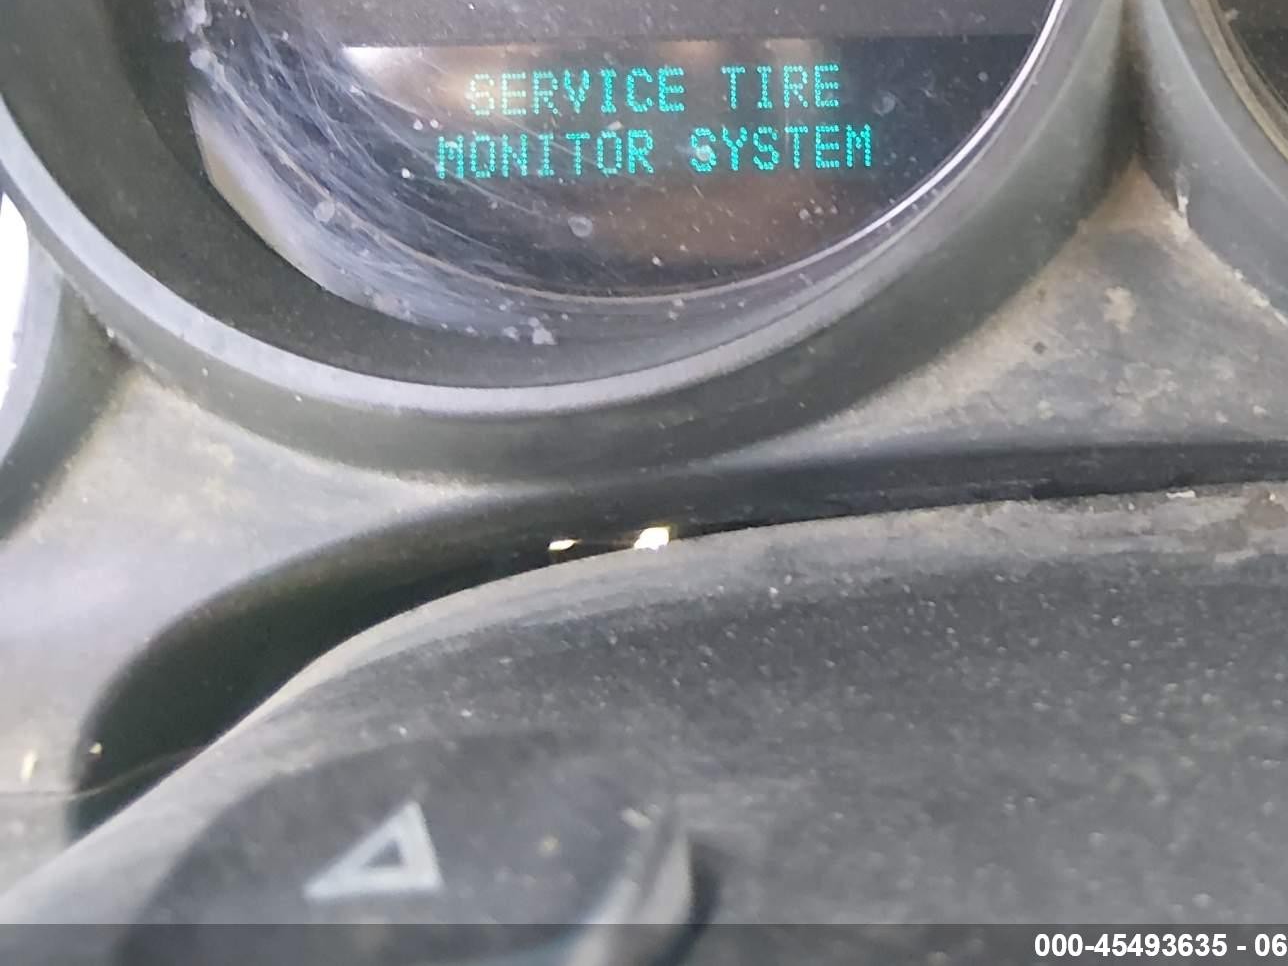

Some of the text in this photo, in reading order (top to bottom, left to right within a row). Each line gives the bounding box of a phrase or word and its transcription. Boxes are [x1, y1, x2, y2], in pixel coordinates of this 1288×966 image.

[470, 63, 841, 116] SERVICE TIRE
[436, 125, 873, 179] MONITOR SYSTEM
